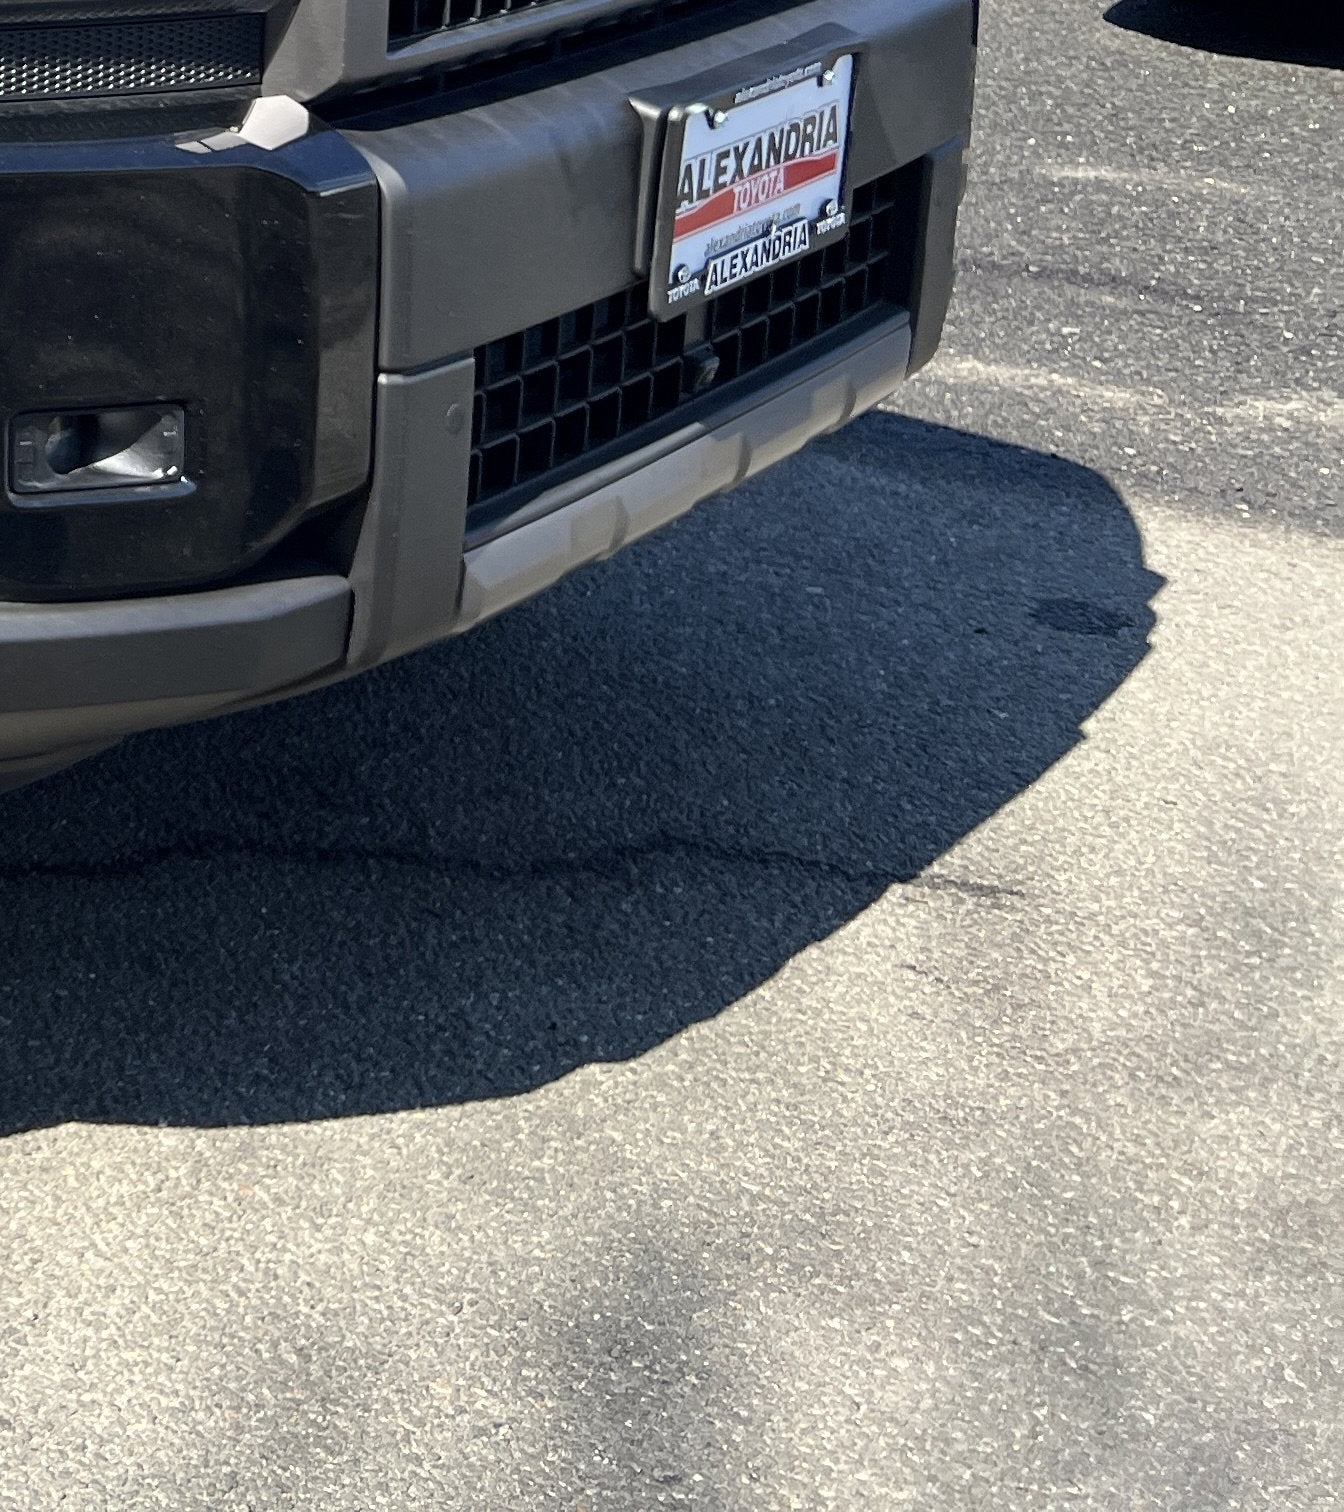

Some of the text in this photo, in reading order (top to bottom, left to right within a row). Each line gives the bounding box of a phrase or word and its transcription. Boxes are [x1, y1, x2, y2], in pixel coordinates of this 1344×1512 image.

[676, 103, 839, 206] ALEXANDRIA
[733, 167, 785, 213] TOYOTA
[707, 221, 810, 292] ALEXANDRIA
